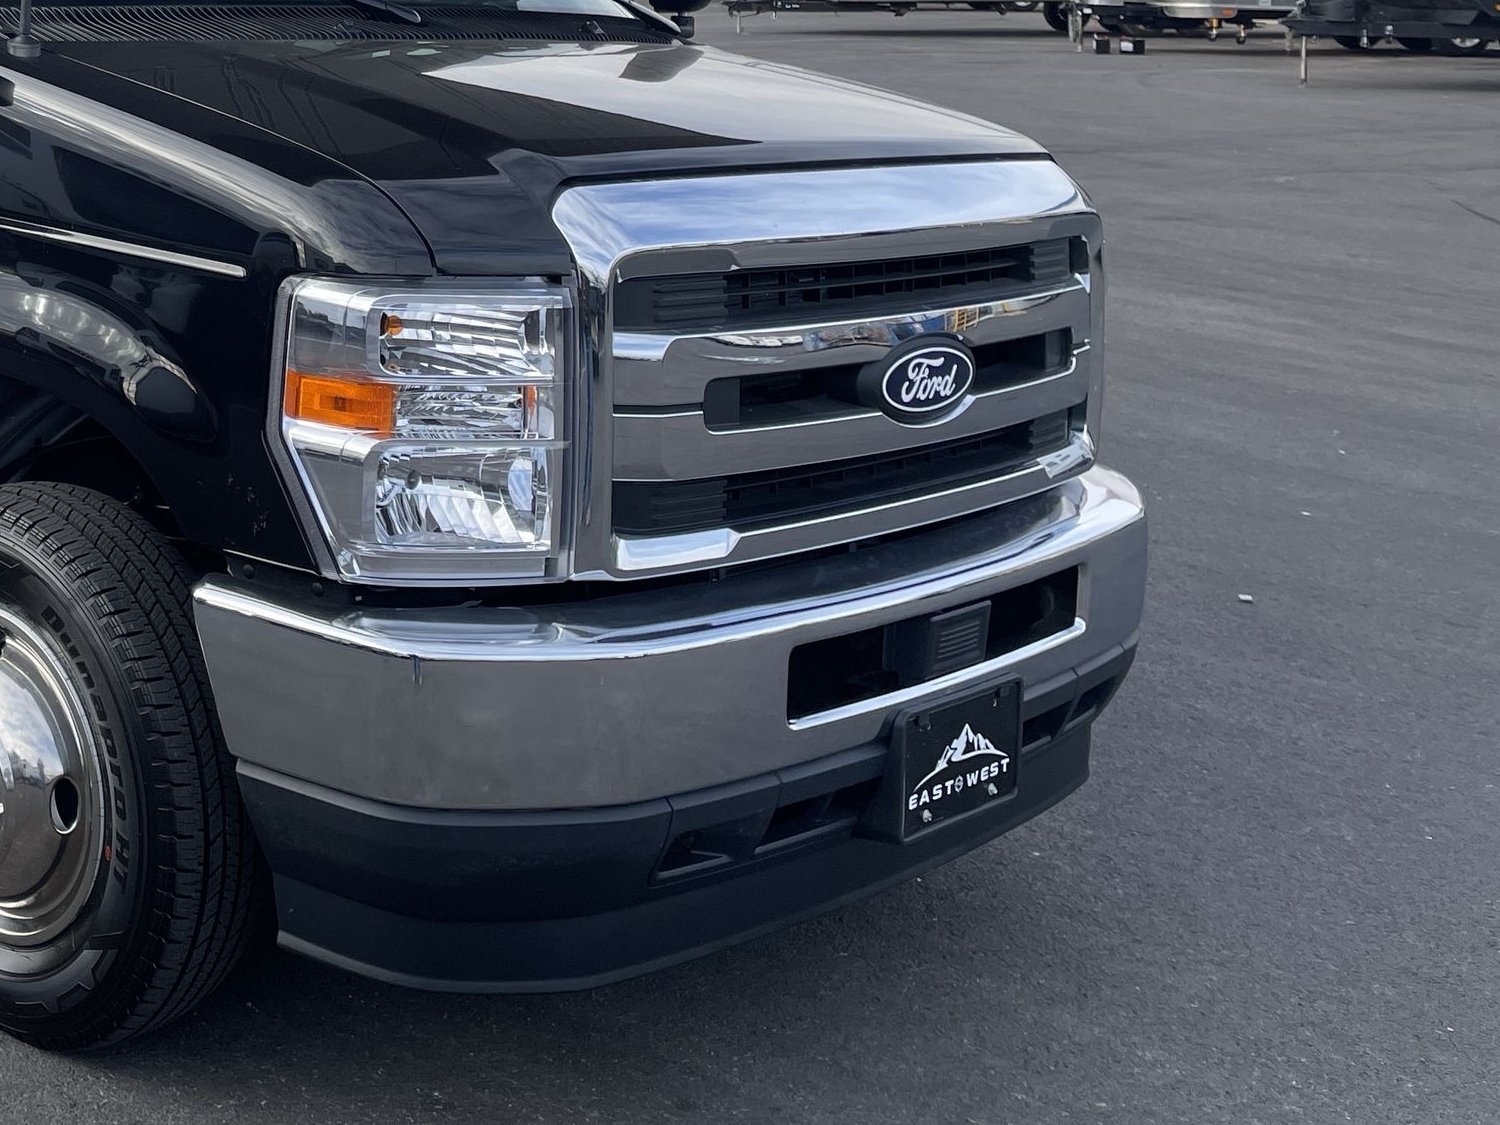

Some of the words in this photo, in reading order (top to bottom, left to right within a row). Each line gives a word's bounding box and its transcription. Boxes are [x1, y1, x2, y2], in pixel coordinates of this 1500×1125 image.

[901, 357, 958, 404] Ford
[908, 779, 955, 811] EAST
[966, 758, 1010, 787] WEST
